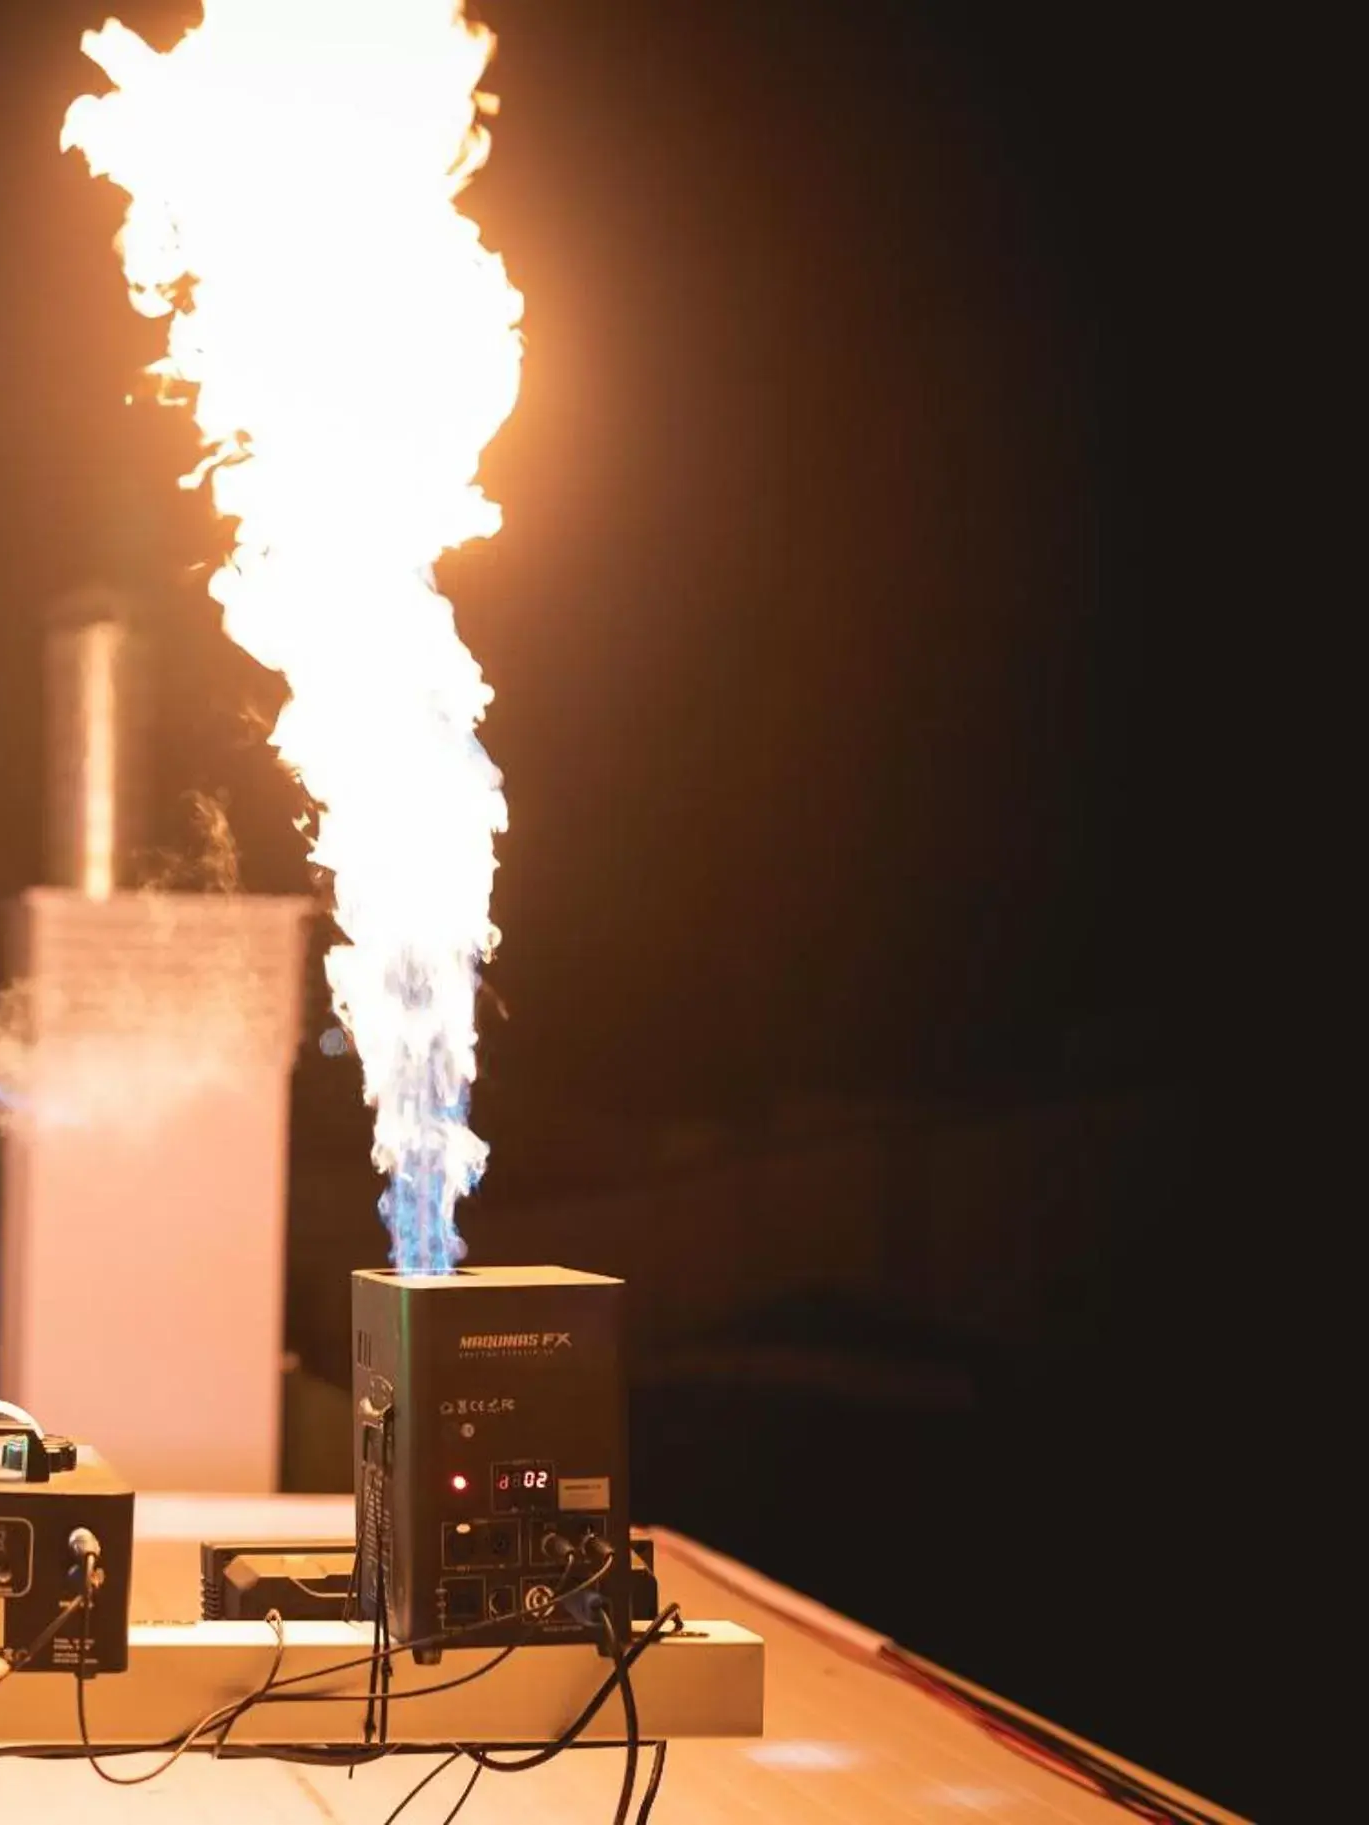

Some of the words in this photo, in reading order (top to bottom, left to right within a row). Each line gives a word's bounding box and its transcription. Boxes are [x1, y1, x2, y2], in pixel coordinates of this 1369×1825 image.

[459, 1334, 539, 1350] MAQUINAS
[542, 1332, 573, 1348] FX
[523, 1470, 548, 1488] 02
